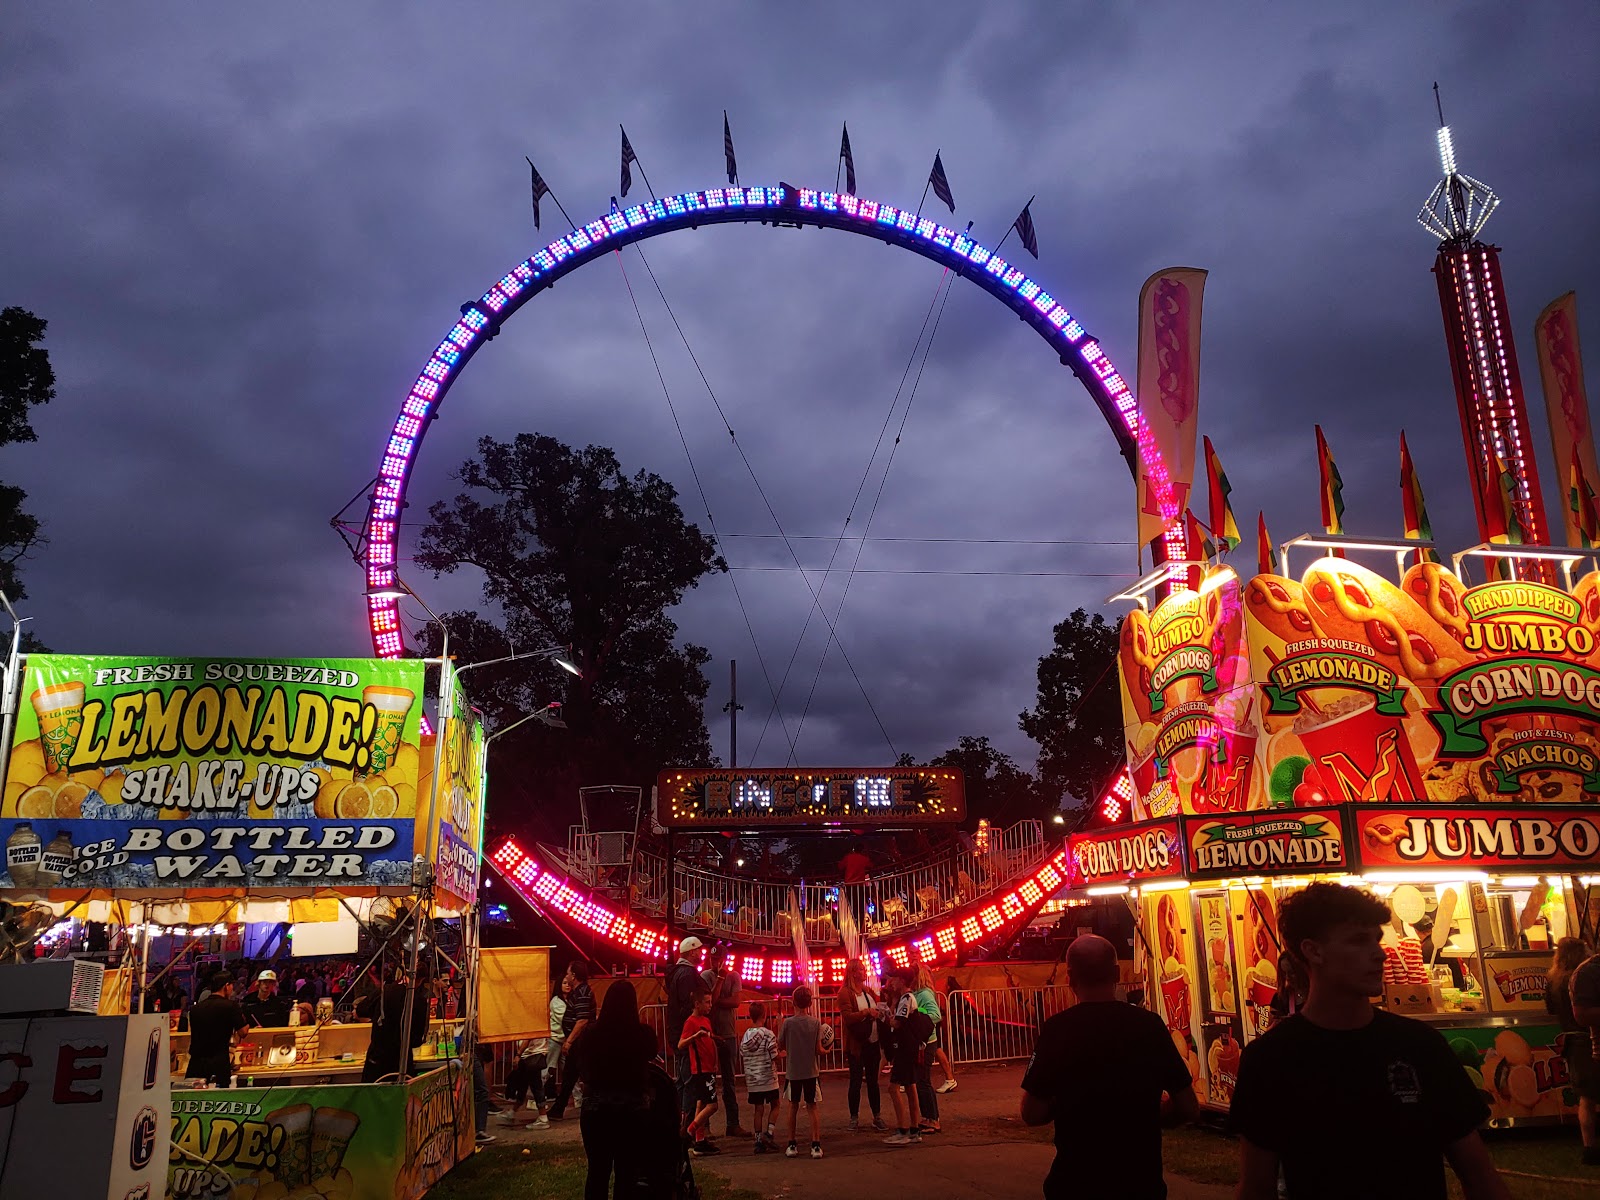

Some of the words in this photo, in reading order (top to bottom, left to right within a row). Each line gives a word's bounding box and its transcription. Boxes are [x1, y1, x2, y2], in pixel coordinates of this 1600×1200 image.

[1468, 589, 1515, 615] HAND
[1516, 587, 1575, 619] DIPPED
[1152, 616, 1205, 657] JUMBO
[1286, 639, 1319, 654] FRESH
[1321, 638, 1376, 657] SQUEEZED
[1464, 622, 1595, 653] JUMBO
[93, 663, 195, 688] FRESH
[205, 663, 360, 688] SQUEEZED
[1153, 655, 1179, 691] CORN
[1179, 649, 1211, 672] DOGS
[1276, 657, 1392, 691] LEMONADE
[1452, 666, 1534, 715] CORN
[69, 686, 378, 770] LEMONADE!
[1162, 707, 1179, 727] FRESH
[1179, 700, 1210, 716] SQUEEZED
[1158, 719, 1219, 755] LEMONADE
[1514, 729, 1535, 741] HOT
[1535, 729, 1543, 738] &
[1543, 729, 1576, 742] ZESTY
[1501, 744, 1595, 773] NACHOS
[121, 760, 320, 810] SHAKE-UPS
[704, 779, 796, 811] RING
[828, 778, 915, 811] FIRE
[122, 826, 397, 853] BOTTLED
[1226, 828, 1253, 840] FRESH
[1254, 822, 1302, 836] SQUEEZED
[1399, 818, 1600, 858] JUMBO
[9, 846, 39, 856] BOTTLED
[13, 854, 36, 863] WATER
[73, 838, 116, 860] ICE
[1079, 839, 1119, 876] CORN
[1118, 831, 1169, 870] DOGS
[1197, 838, 1342, 870] LEMONADE
[62, 851, 130, 879] COLD
[154, 854, 364, 880] WATER
[171, 1100, 262, 1116] UEEZED
